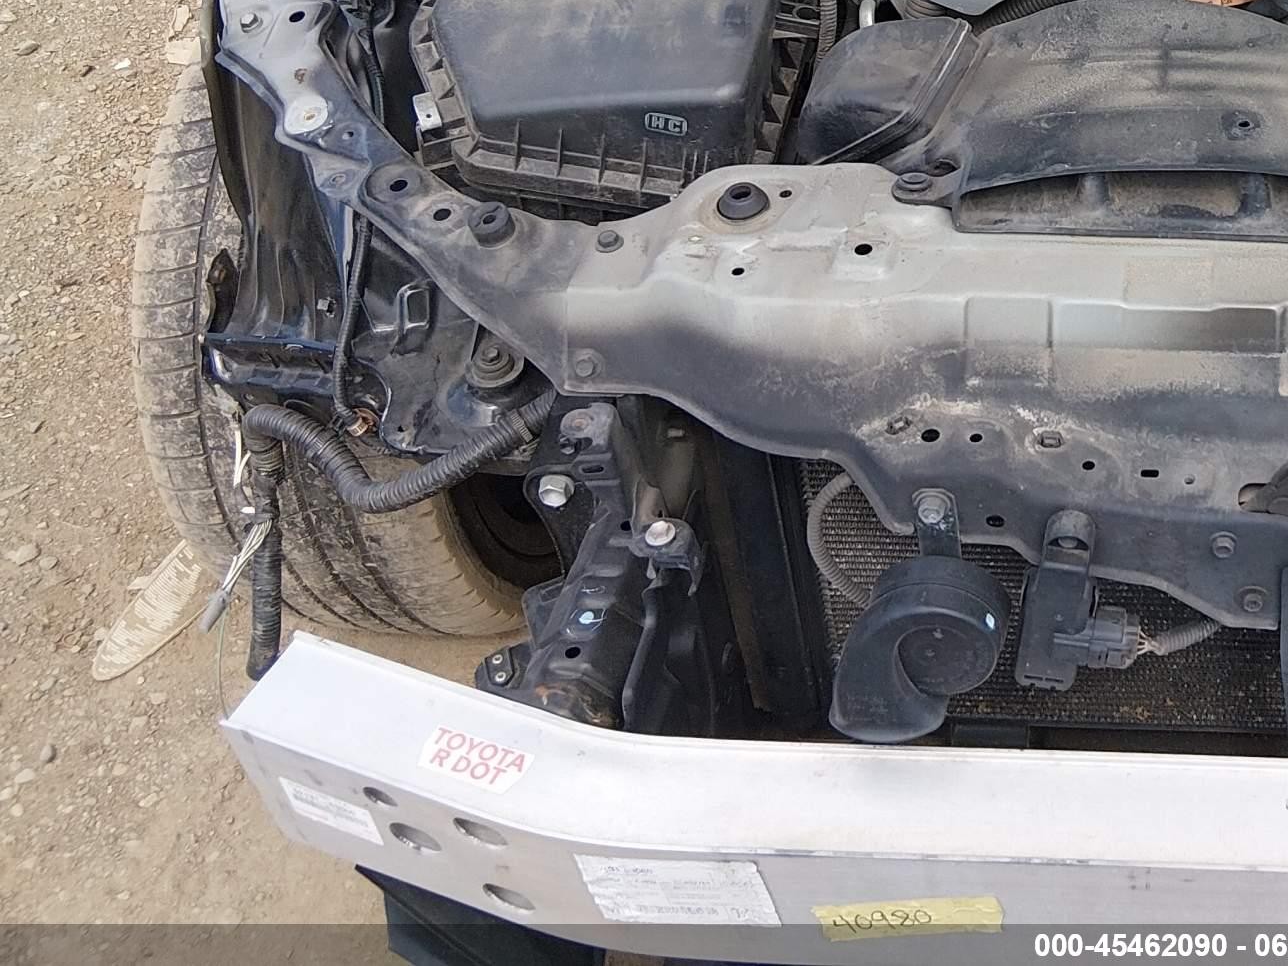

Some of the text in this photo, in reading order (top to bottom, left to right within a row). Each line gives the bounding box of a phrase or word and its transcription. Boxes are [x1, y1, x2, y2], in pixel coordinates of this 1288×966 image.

[430, 747, 507, 785] R DOT
[434, 726, 526, 773] TOYOTA
[832, 909, 932, 934] 40980
